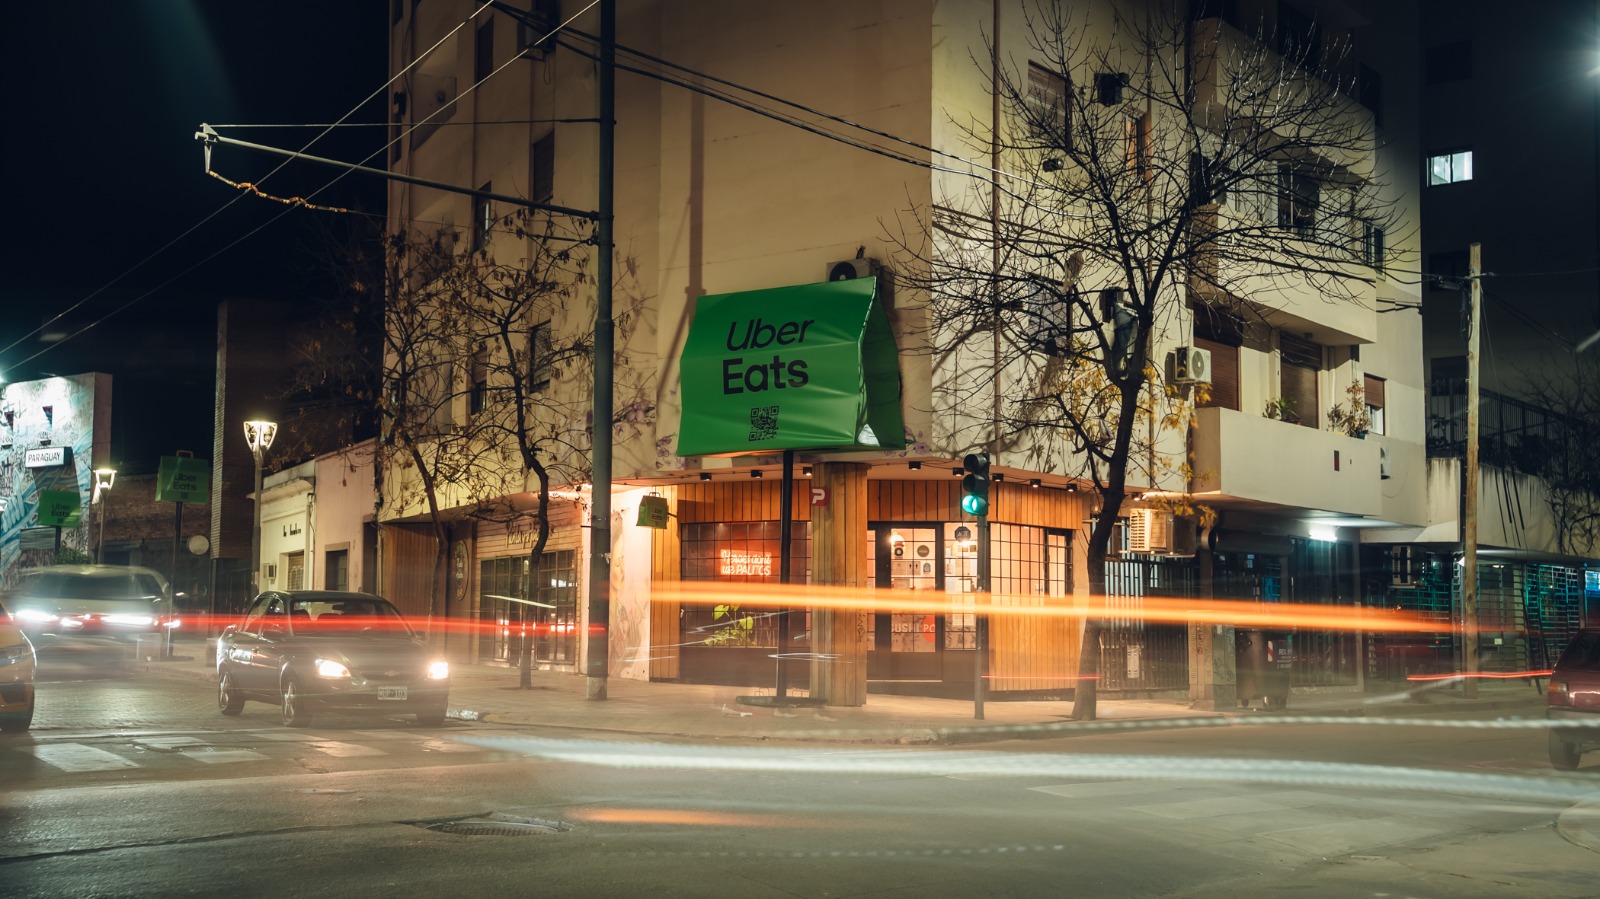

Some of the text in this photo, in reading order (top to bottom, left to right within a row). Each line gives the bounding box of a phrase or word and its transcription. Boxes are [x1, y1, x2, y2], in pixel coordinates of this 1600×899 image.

[726, 318, 815, 352] Uber
[723, 355, 809, 395] Eats
[28, 452, 61, 463] PARAGUAY
[173, 481, 197, 490] Eats
